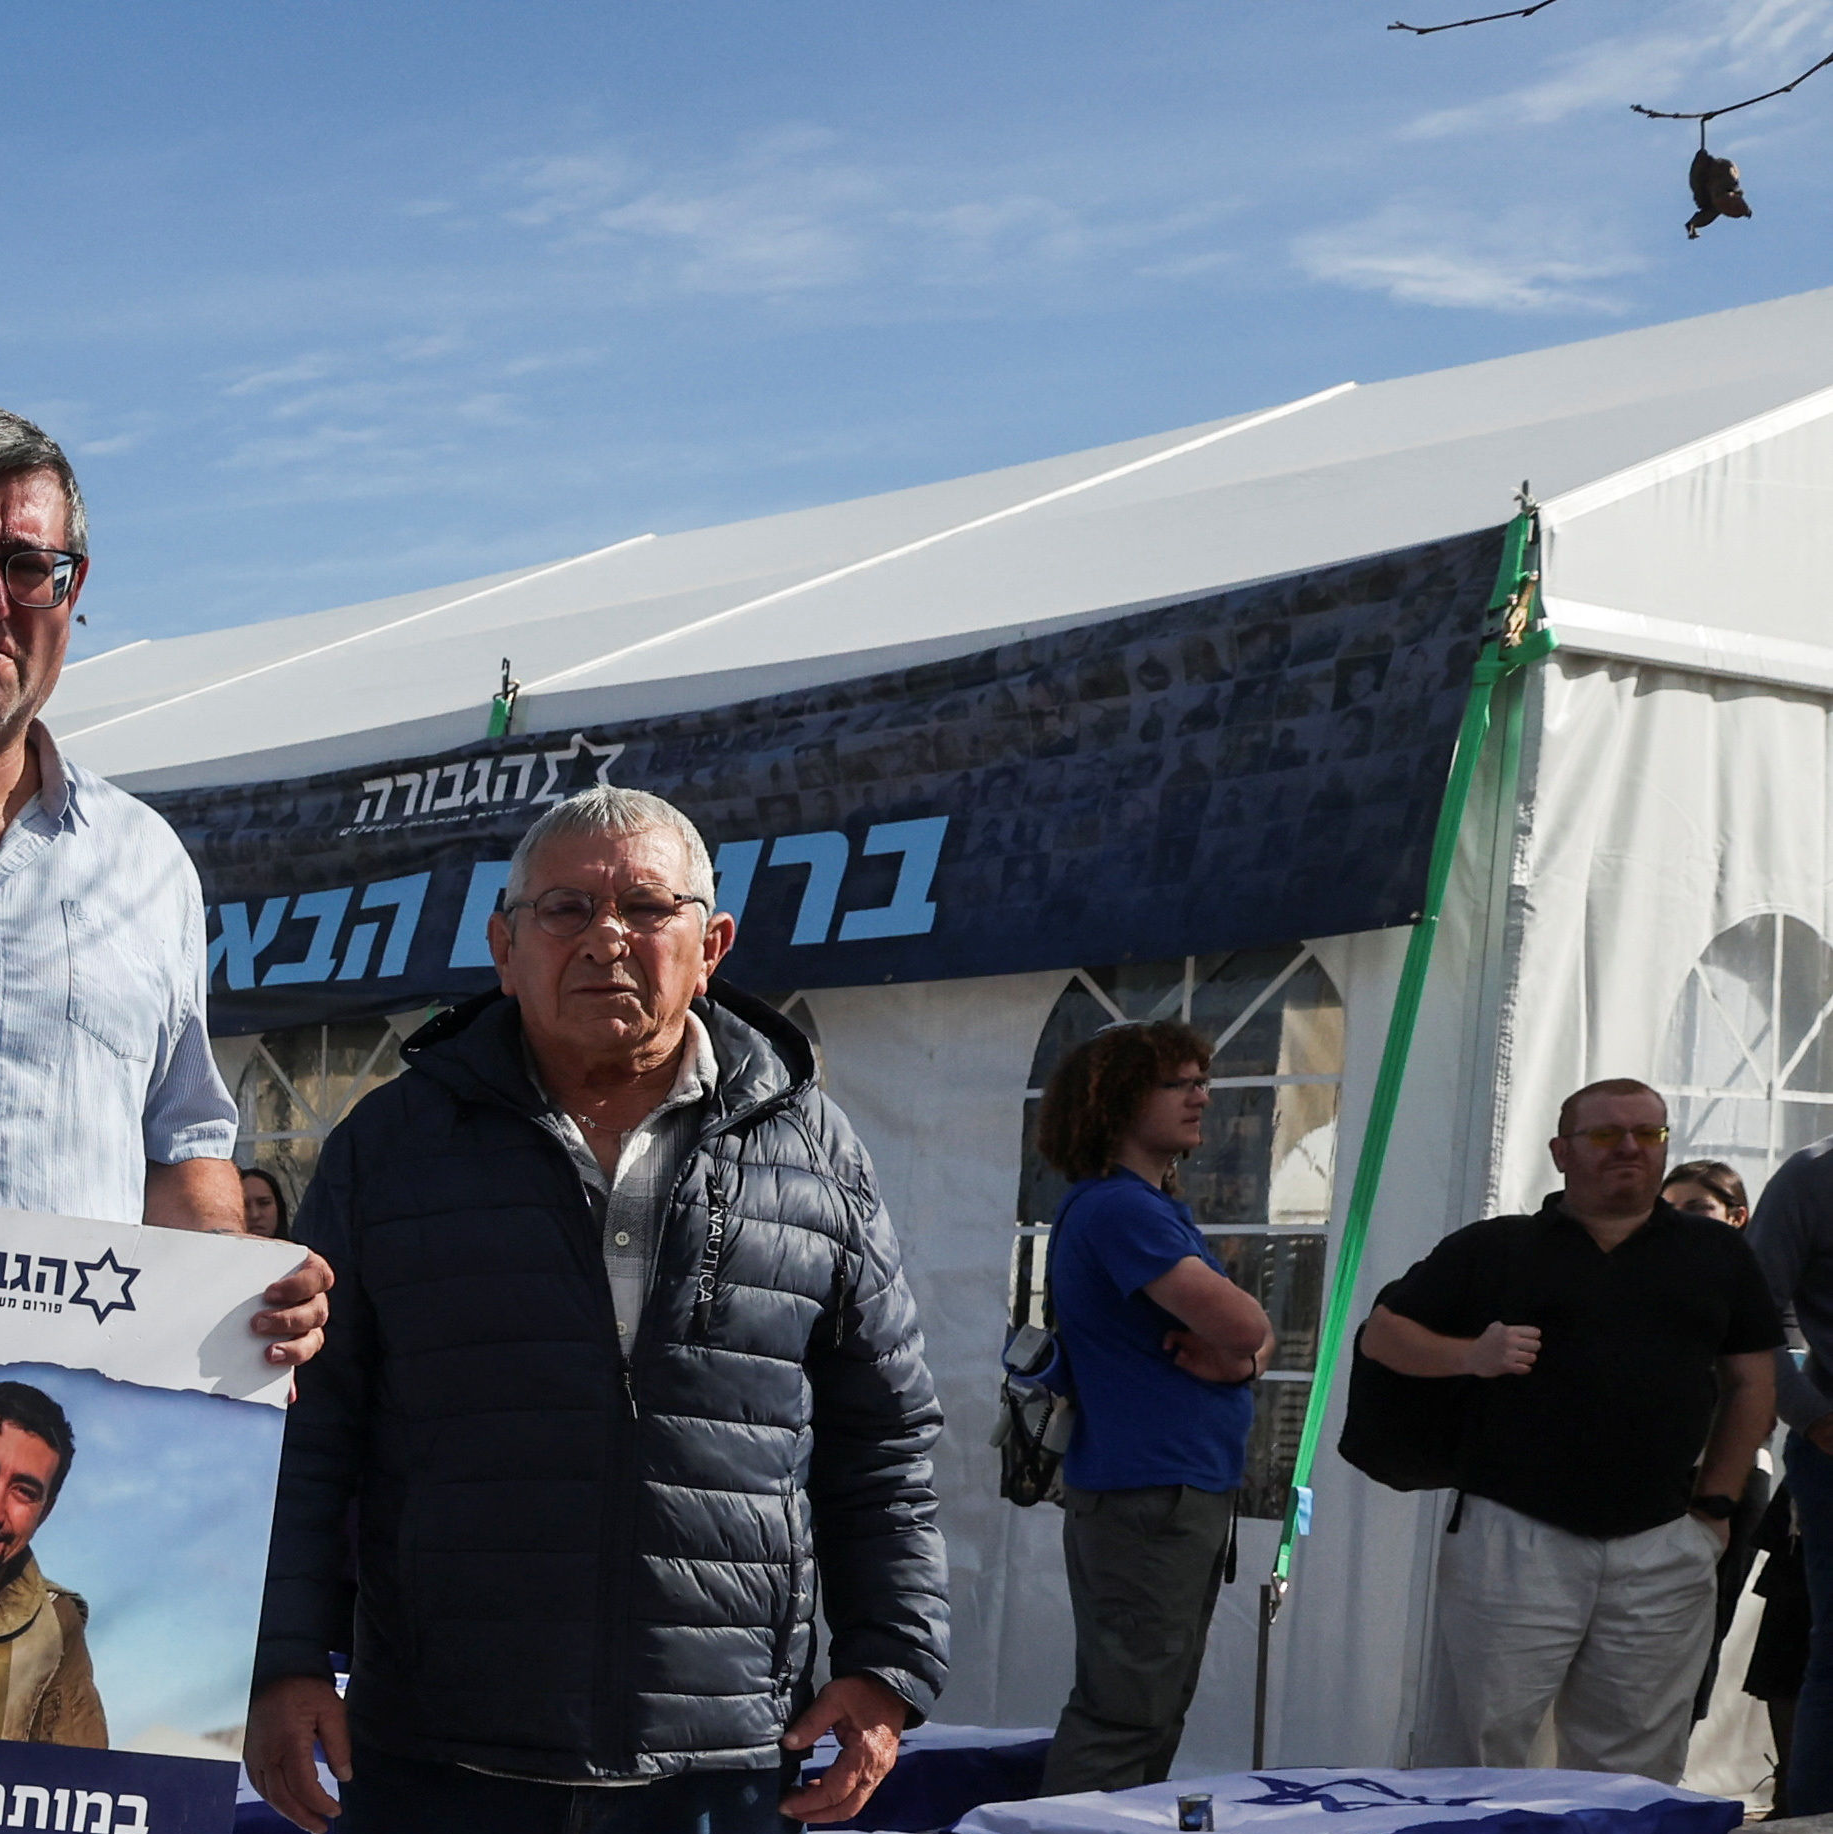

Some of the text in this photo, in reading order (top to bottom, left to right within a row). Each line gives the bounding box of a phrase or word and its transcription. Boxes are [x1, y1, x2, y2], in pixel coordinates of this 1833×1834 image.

[353, 753, 537, 824] הגבורה
[206, 871, 432, 994] הבא
[22, 1300, 63, 1314] פורום
